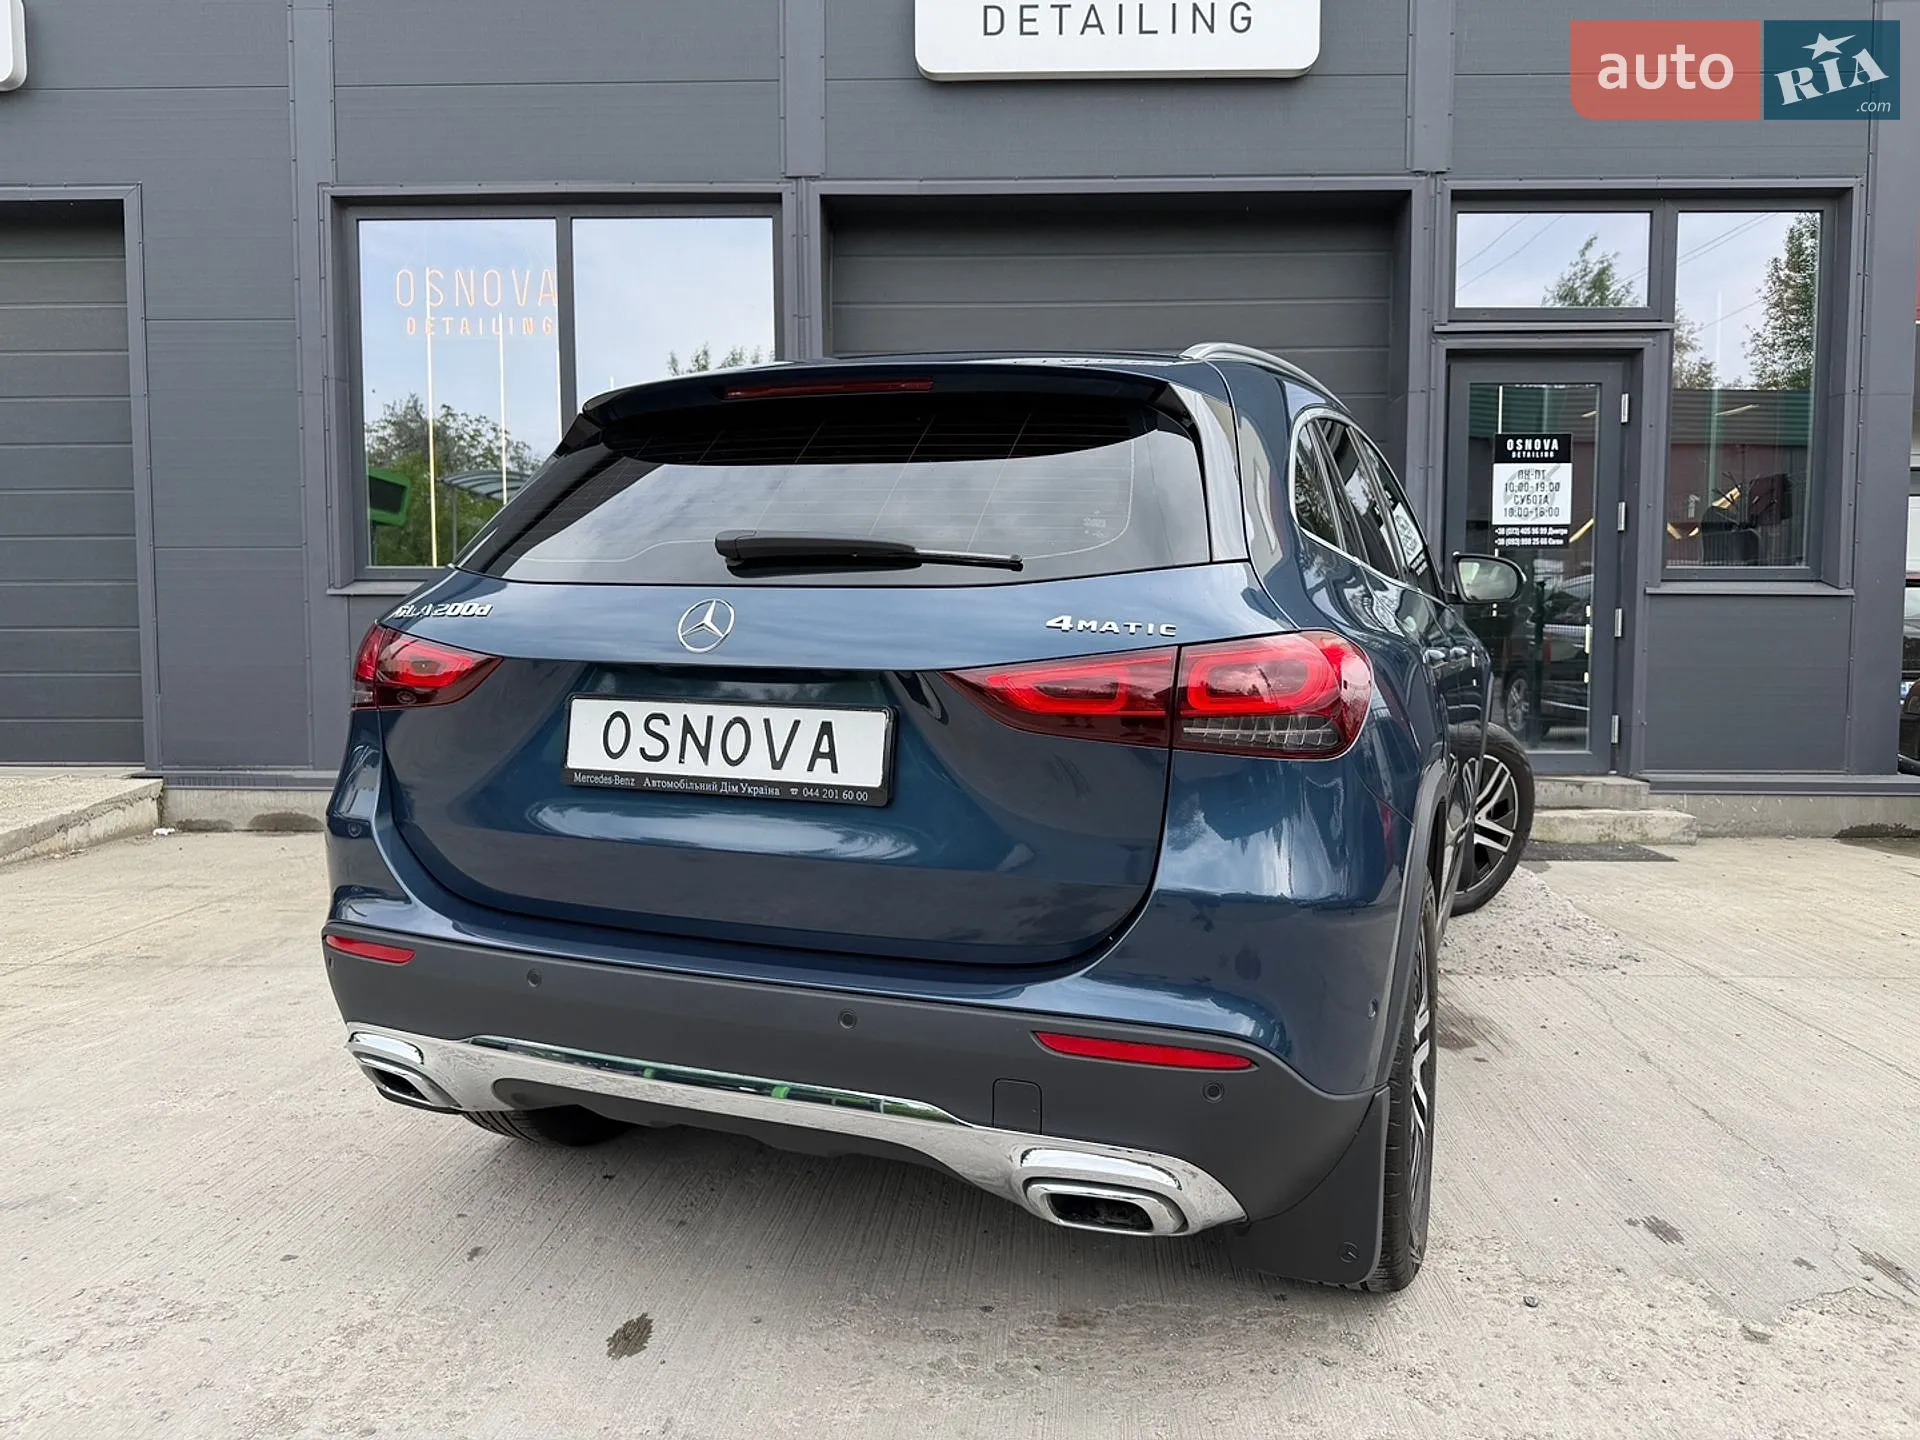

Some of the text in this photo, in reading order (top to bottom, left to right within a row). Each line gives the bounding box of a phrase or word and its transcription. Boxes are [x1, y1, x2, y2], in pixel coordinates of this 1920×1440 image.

[983, 1, 1253, 36] DETAILING
[396, 268, 557, 307] OSNOVA
[407, 316, 553, 336] DETAILING
[1506, 438, 1559, 451] OSNOVA
[1513, 494, 1549, 505] СУБОТА
[1046, 614, 1177, 637] 4MATIC
[602, 710, 839, 774] OSNOVA
[573, 772, 868, 802] Mercedes-Benz Автомобільний Дім Україна 044 201 60 00
